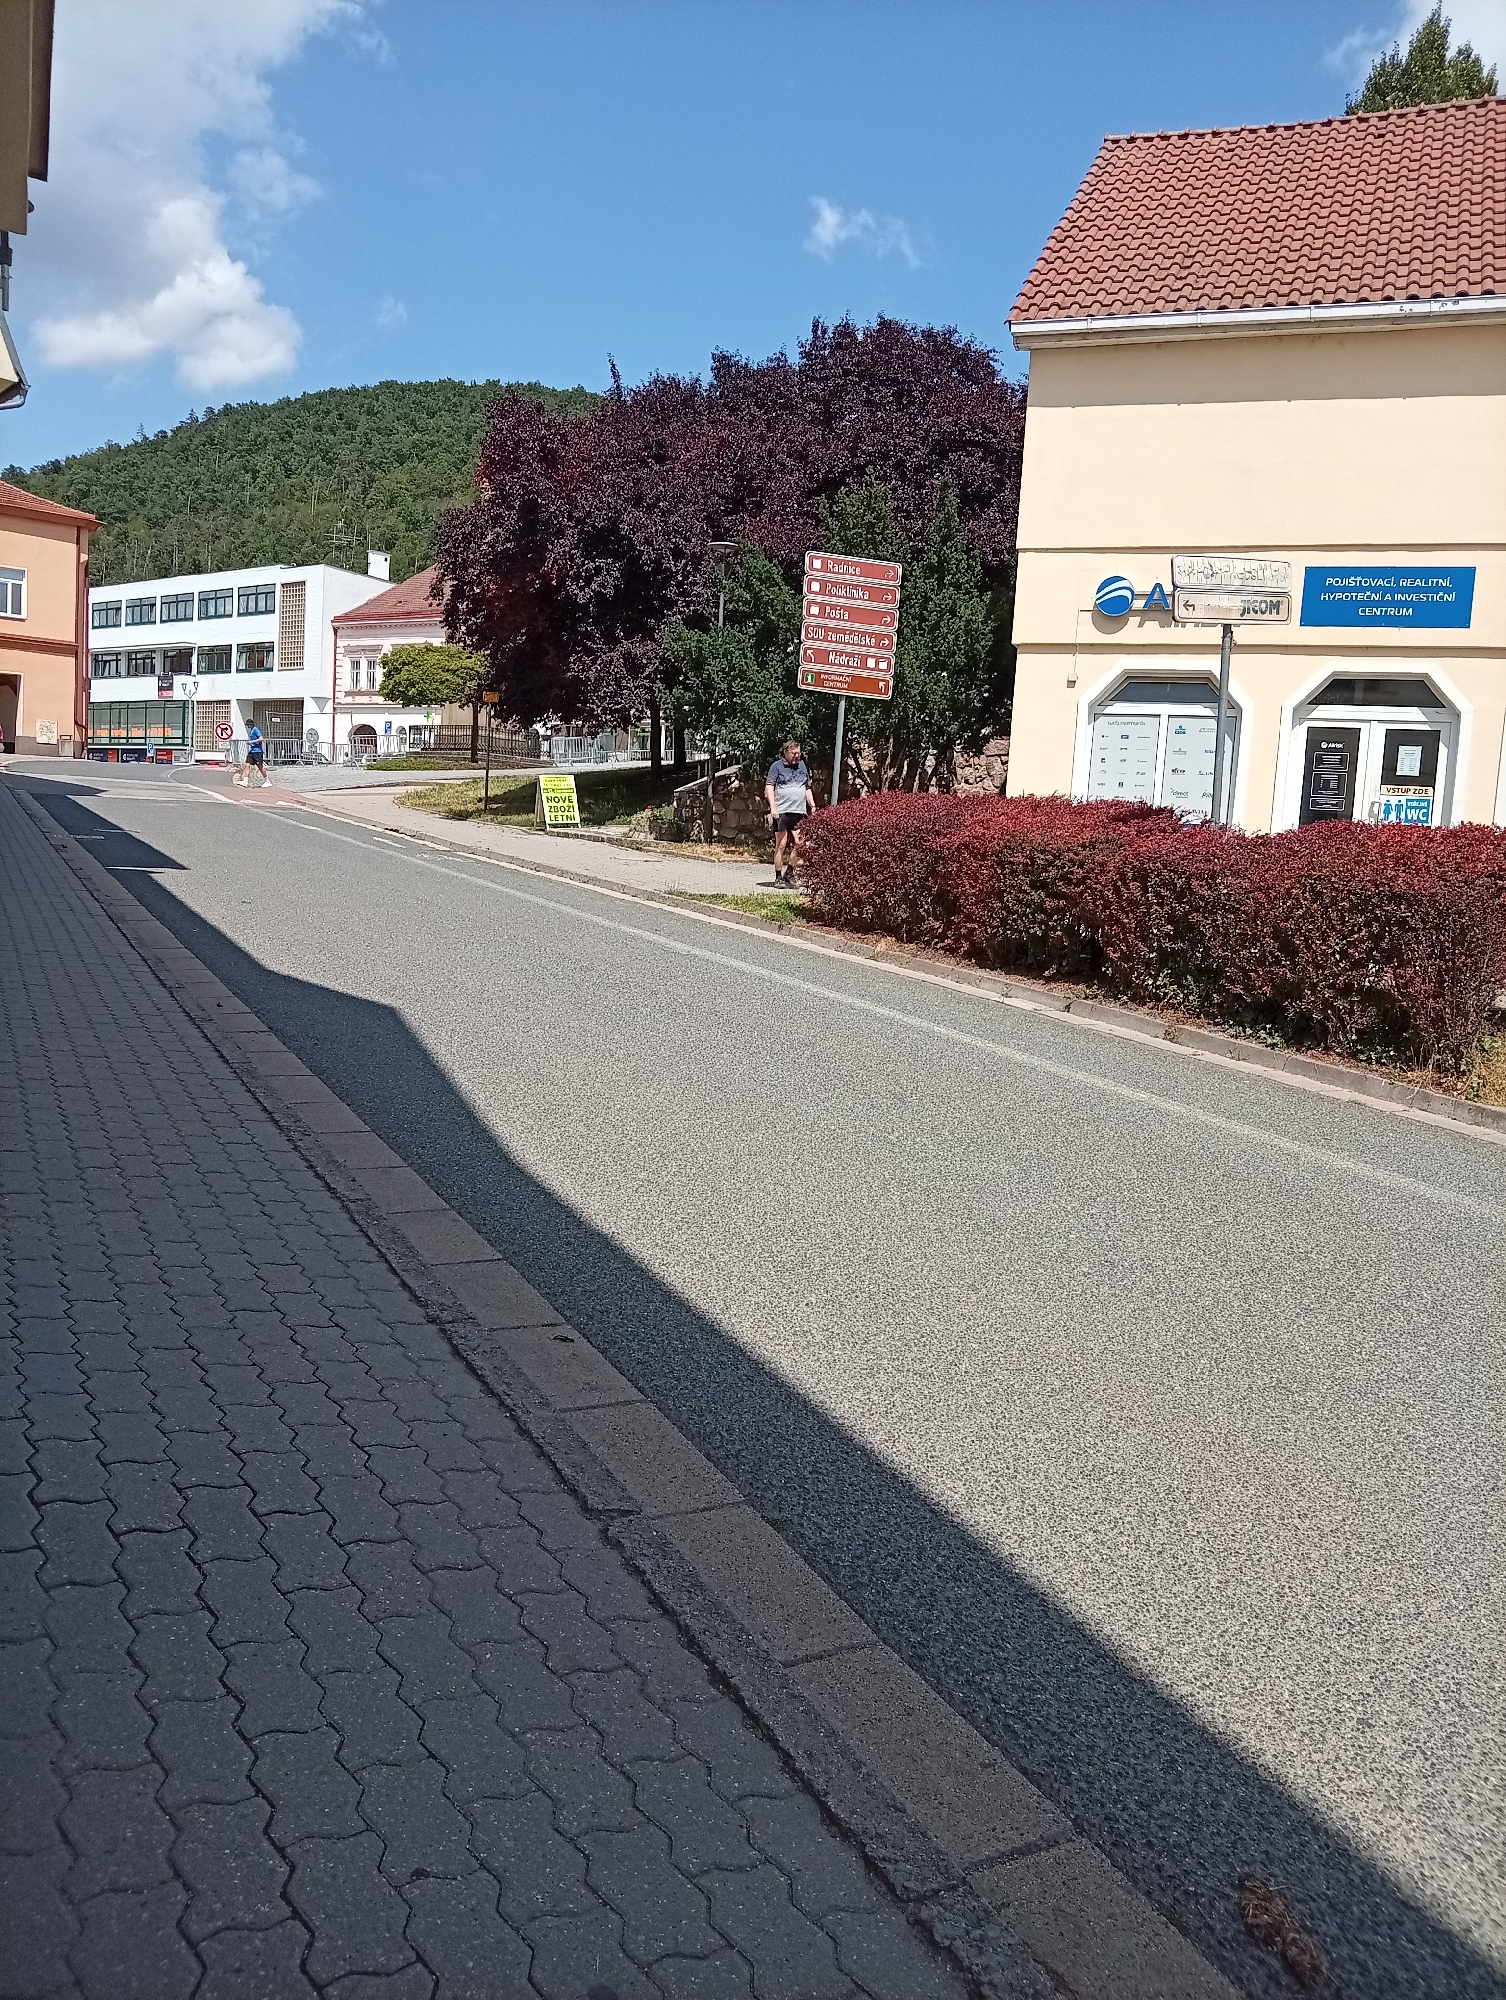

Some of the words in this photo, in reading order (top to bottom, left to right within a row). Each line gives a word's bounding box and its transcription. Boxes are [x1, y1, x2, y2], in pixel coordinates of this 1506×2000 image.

[827, 559, 861, 576] Radnice
[1325, 576, 1397, 588] POJIŠŤOVACÍ,
[1399, 576, 1453, 588] REALITNÍ,
[826, 583, 869, 600] Poliklinika
[1320, 591, 1382, 601] HYPOTEČNÍ
[1384, 593, 1392, 601] A
[1394, 591, 1456, 602] INVESTIČNÍ
[825, 605, 849, 620] Pošta
[1358, 607, 1413, 616] CENTRUM
[827, 630, 876, 647] zemědělské
[828, 651, 861, 667] Nádraží
[820, 674, 852, 683] INFORMAČNÍ
[823, 680, 848, 689] CENTRUM
[546, 793, 573, 803] NOVÉ
[1406, 808, 1428, 820] WC
